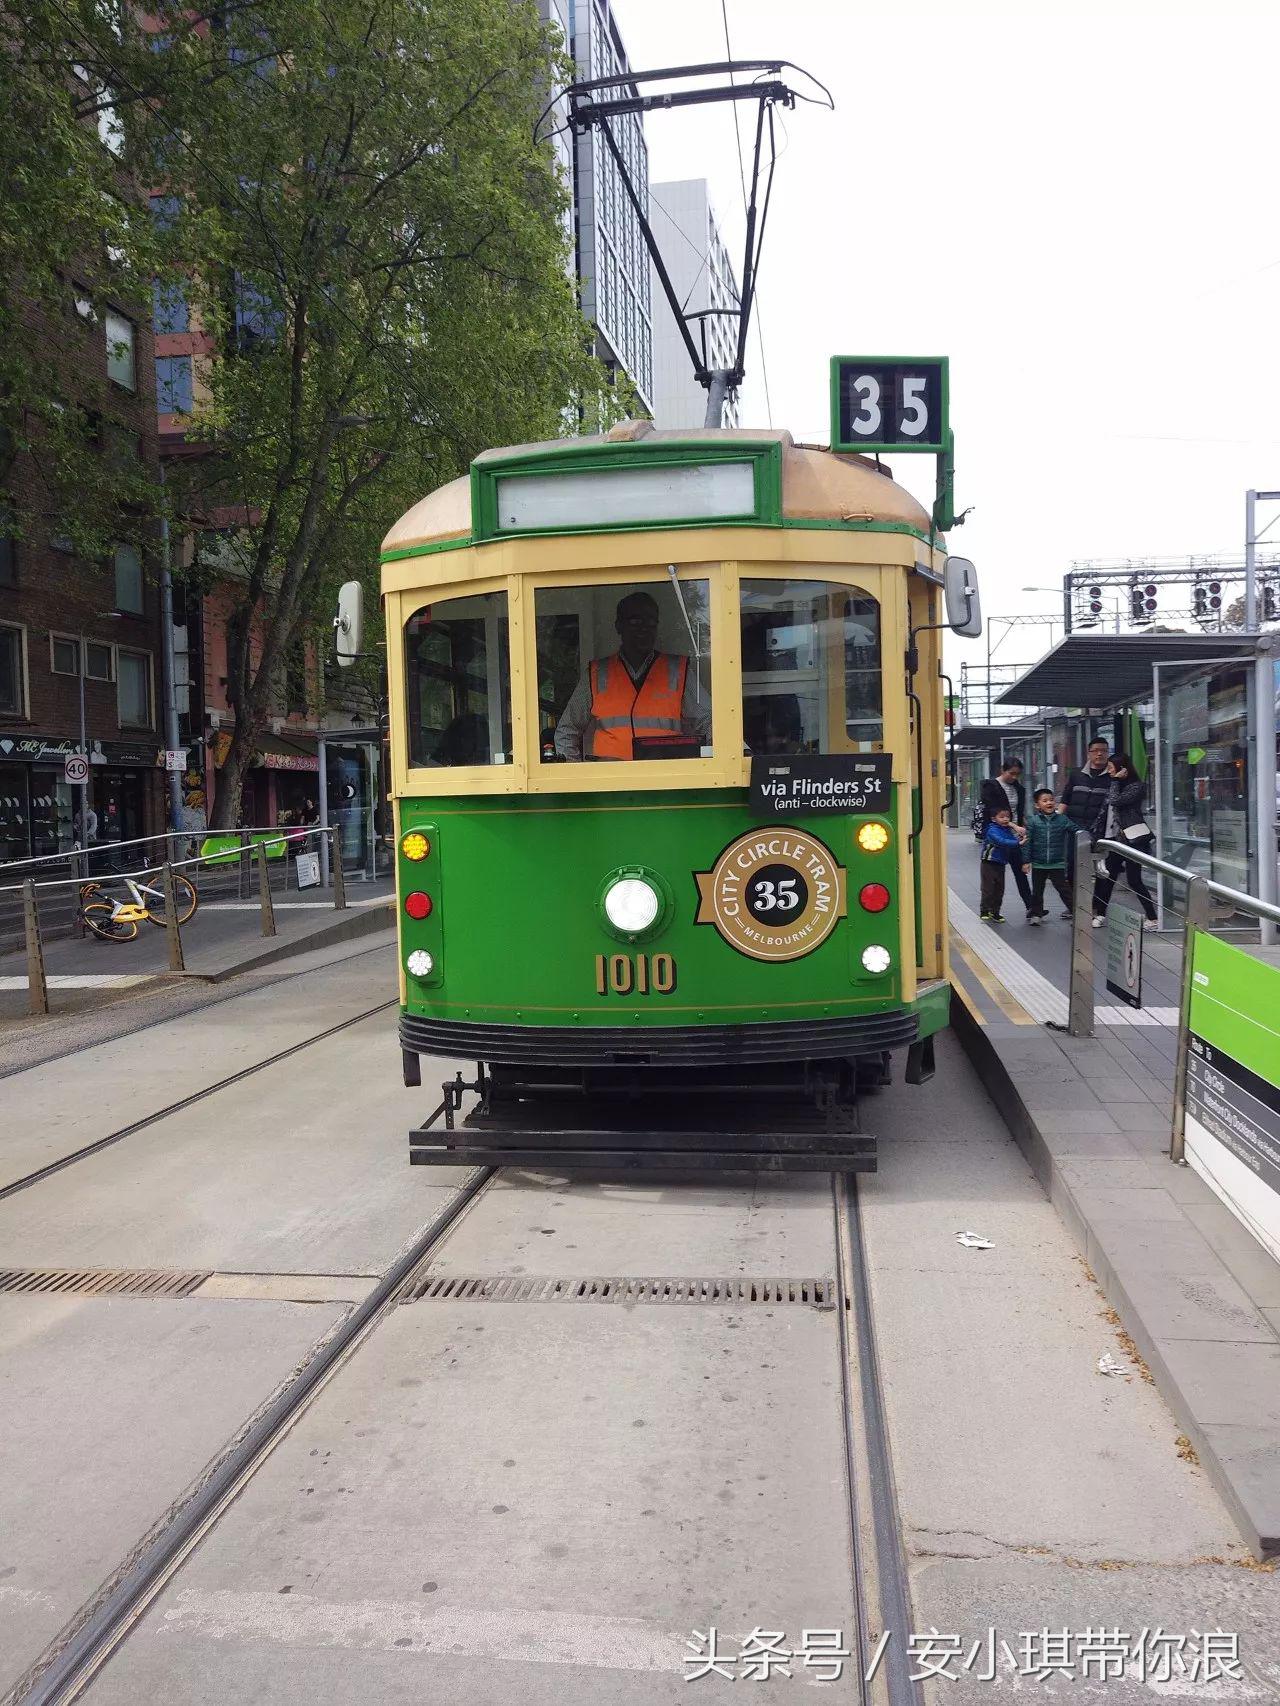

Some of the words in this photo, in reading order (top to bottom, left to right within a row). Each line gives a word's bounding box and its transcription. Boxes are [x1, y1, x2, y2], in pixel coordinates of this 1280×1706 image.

[851, 375, 928, 435] 35
[68, 763, 85, 775] 40
[761, 780, 787, 796] via
[792, 778, 859, 795] Flinders
[864, 777, 882, 793] St
[722, 869, 740, 916] CITY
[737, 840, 806, 869] CIRCLE
[805, 853, 831, 913] TRAM
[753, 879, 799, 911] 35
[743, 924, 814, 945] MELBOURNE
[595, 953, 678, 996] 1010
